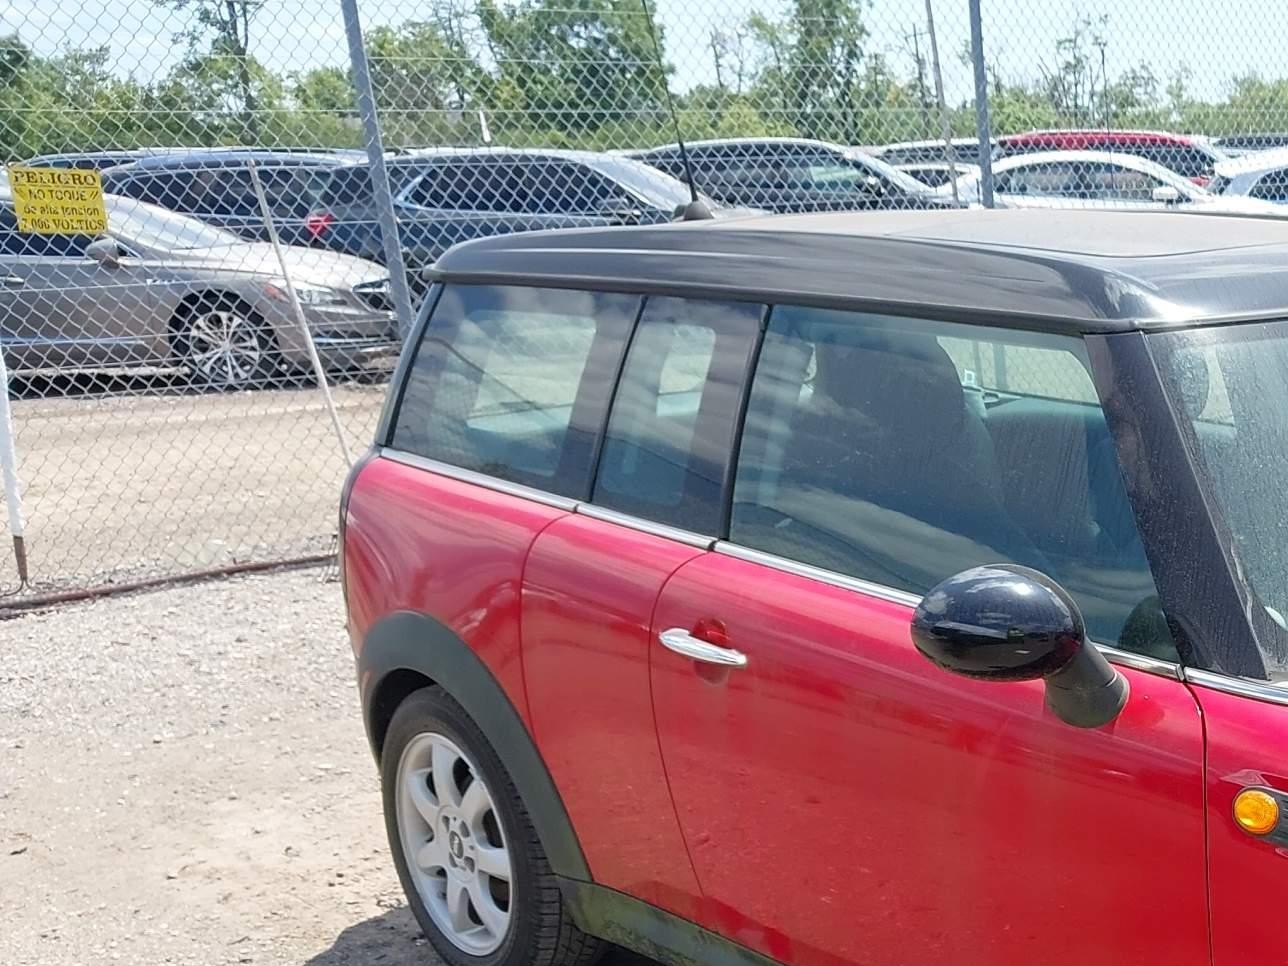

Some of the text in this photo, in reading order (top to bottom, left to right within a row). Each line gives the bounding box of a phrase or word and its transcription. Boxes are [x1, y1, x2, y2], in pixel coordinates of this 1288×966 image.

[13, 170, 96, 186] PELIGRO
[29, 188, 87, 201] NO TOQUE
